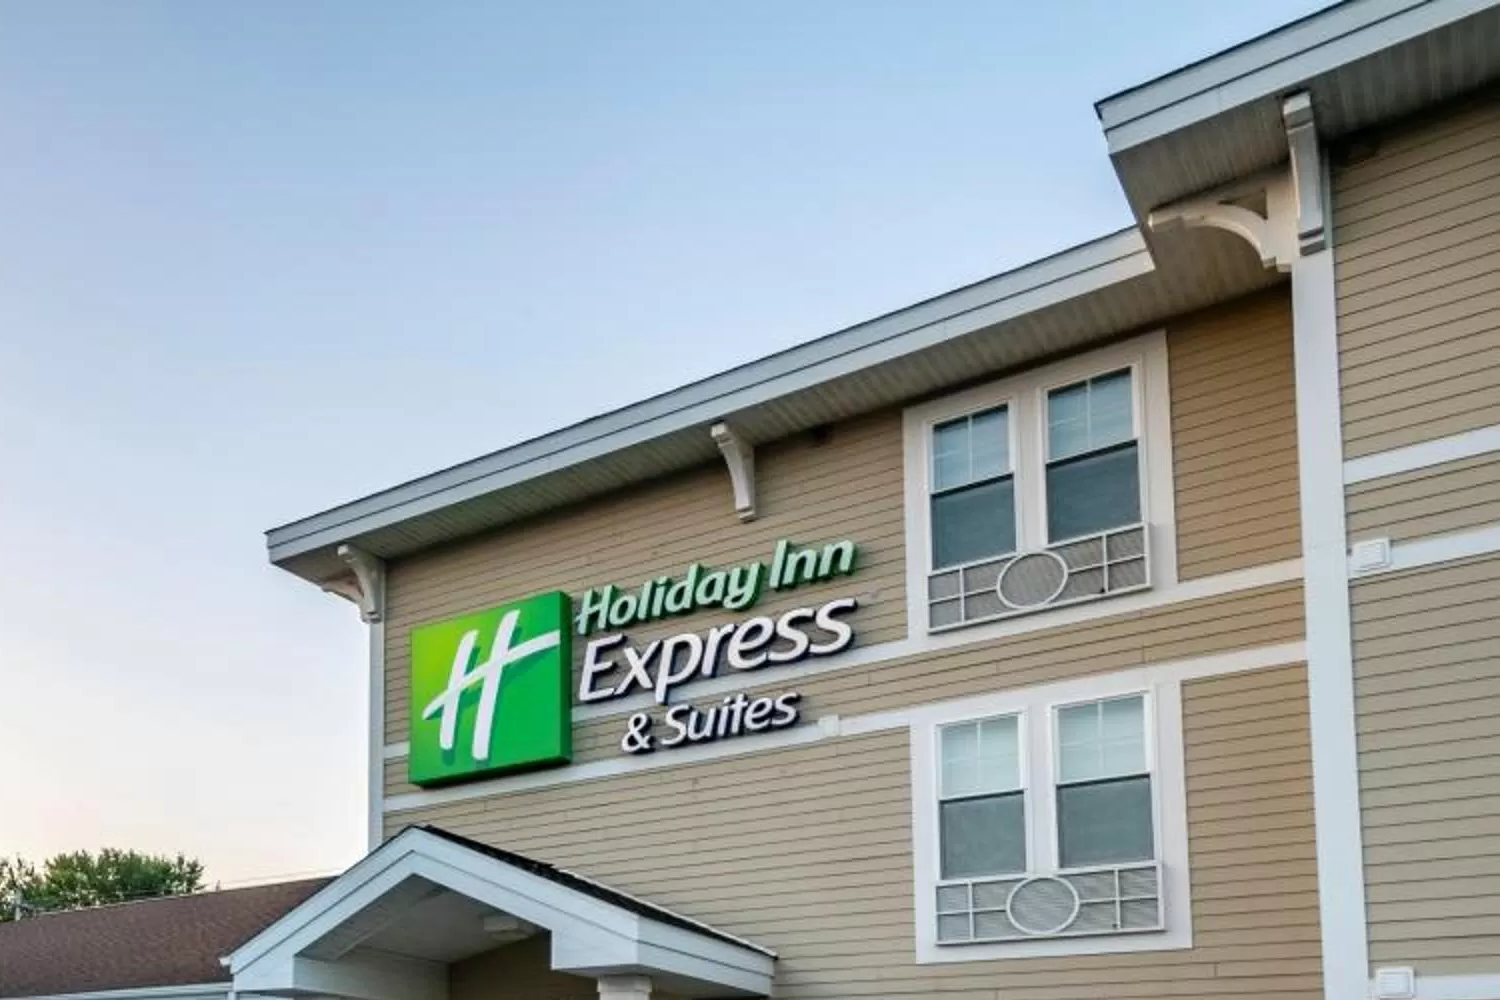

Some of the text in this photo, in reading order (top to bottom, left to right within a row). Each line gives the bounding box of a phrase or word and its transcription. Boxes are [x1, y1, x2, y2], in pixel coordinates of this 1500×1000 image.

[574, 539, 857, 636] Holiday Inn
[579, 598, 858, 704] Express
[621, 692, 802, 754] & Suites
